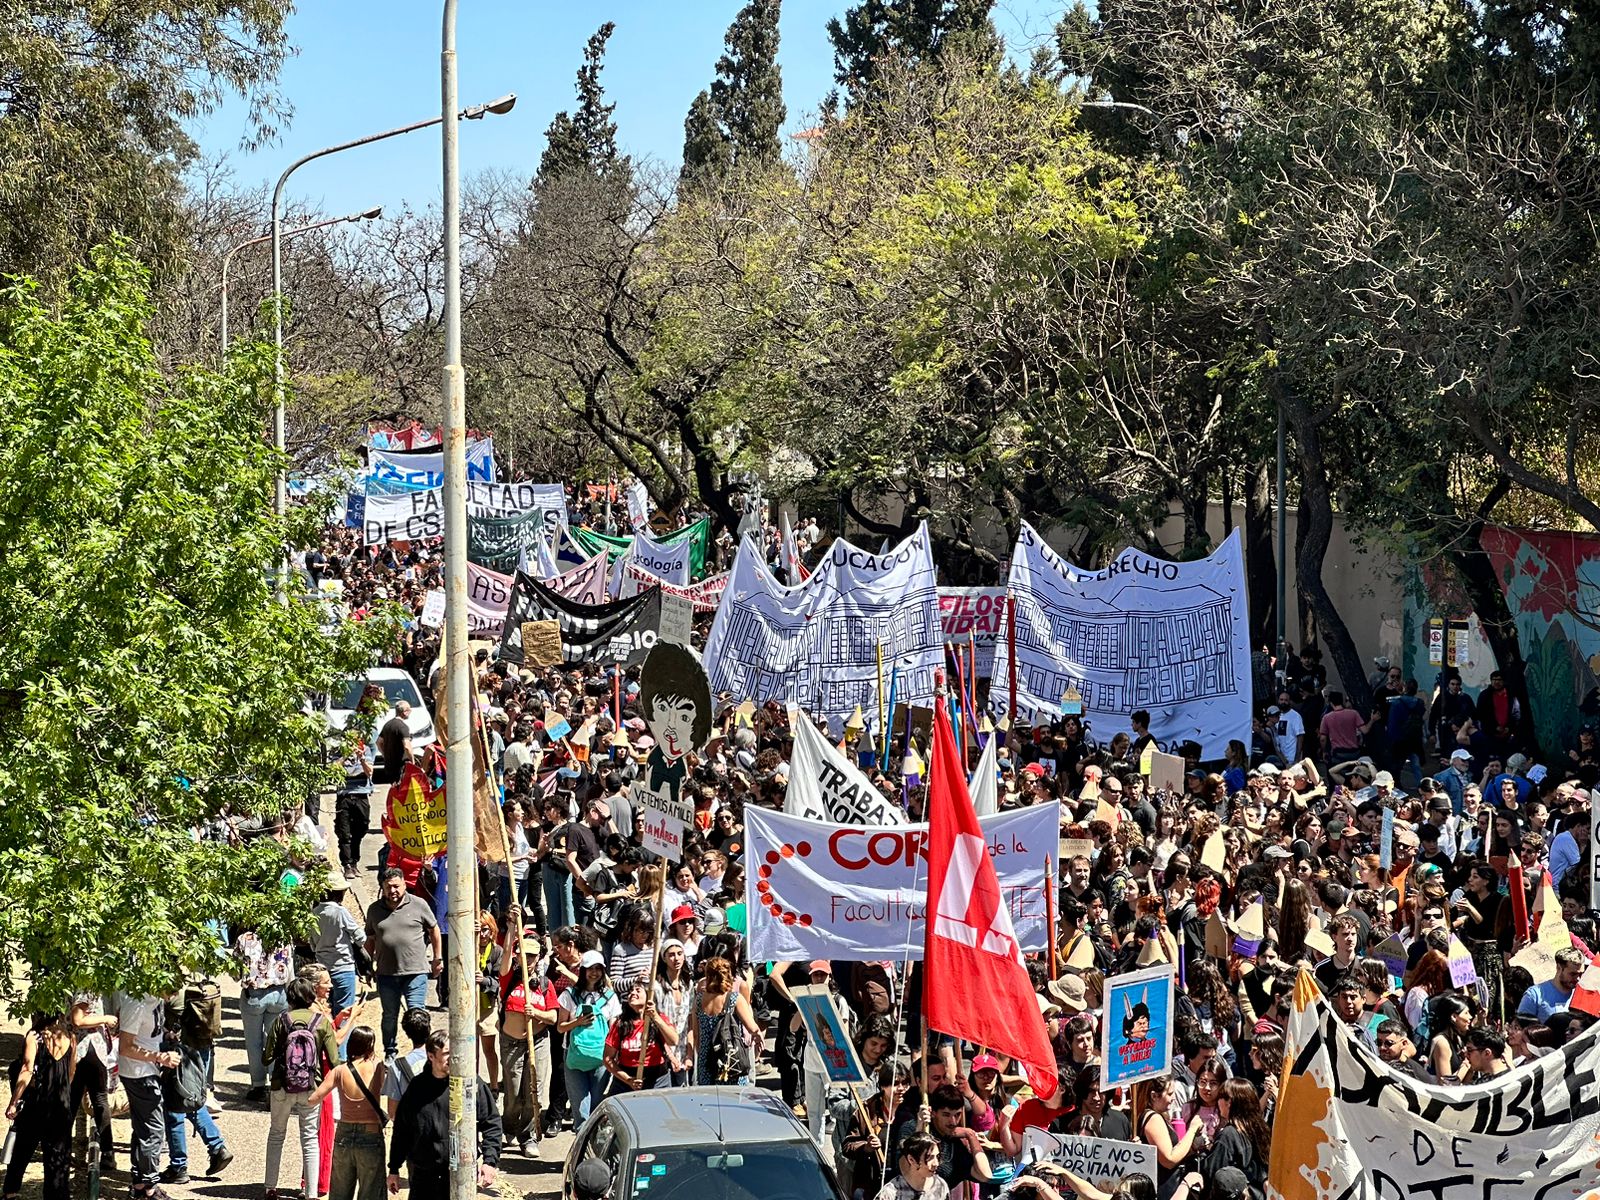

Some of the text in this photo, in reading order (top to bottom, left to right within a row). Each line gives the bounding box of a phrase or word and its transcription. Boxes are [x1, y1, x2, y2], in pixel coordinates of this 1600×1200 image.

[1040, 544, 1070, 579] UN
[402, 799, 437, 813] TODO
[634, 787, 668, 814] VETEMOS
[398, 808, 447, 825] INCENDIO
[415, 824, 428, 834] ES
[986, 834, 1007, 857] de
[1012, 833, 1028, 853] la
[1118, 1038, 1157, 1057] VETEMOS
[1108, 1147, 1145, 1164] NOS
[1413, 1130, 1474, 1168] DE
